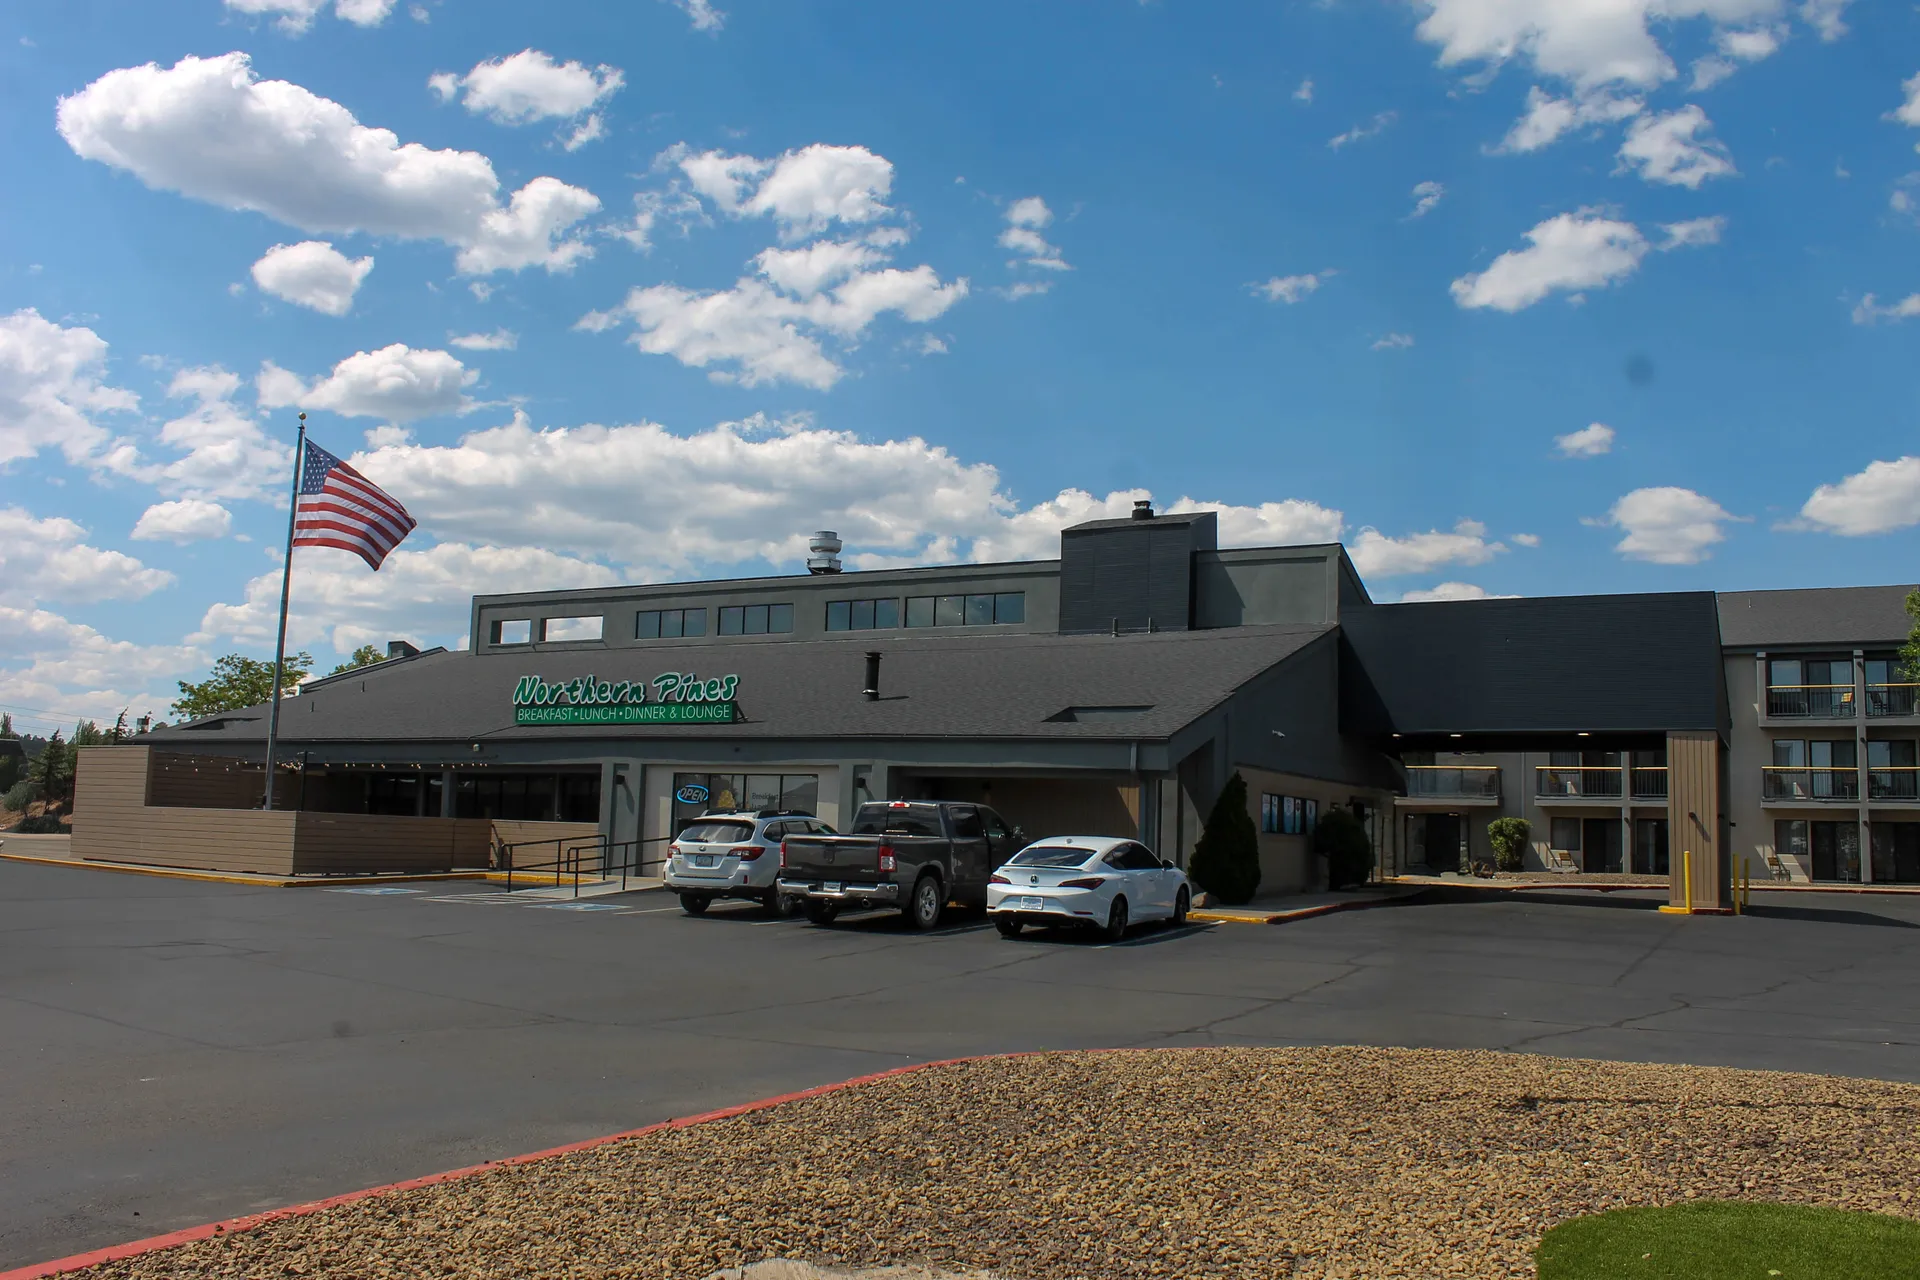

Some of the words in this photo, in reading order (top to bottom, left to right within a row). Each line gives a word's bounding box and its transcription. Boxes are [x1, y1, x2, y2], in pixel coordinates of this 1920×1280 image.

[513, 674, 647, 704] Northern
[652, 672, 740, 702] Pines
[518, 708, 573, 721] BREAKFAST
[579, 707, 616, 720] LUNCH
[624, 706, 665, 719] DINNER
[669, 706, 678, 718] &
[681, 704, 730, 719] LOUNGE
[680, 787, 706, 802] OPEN
